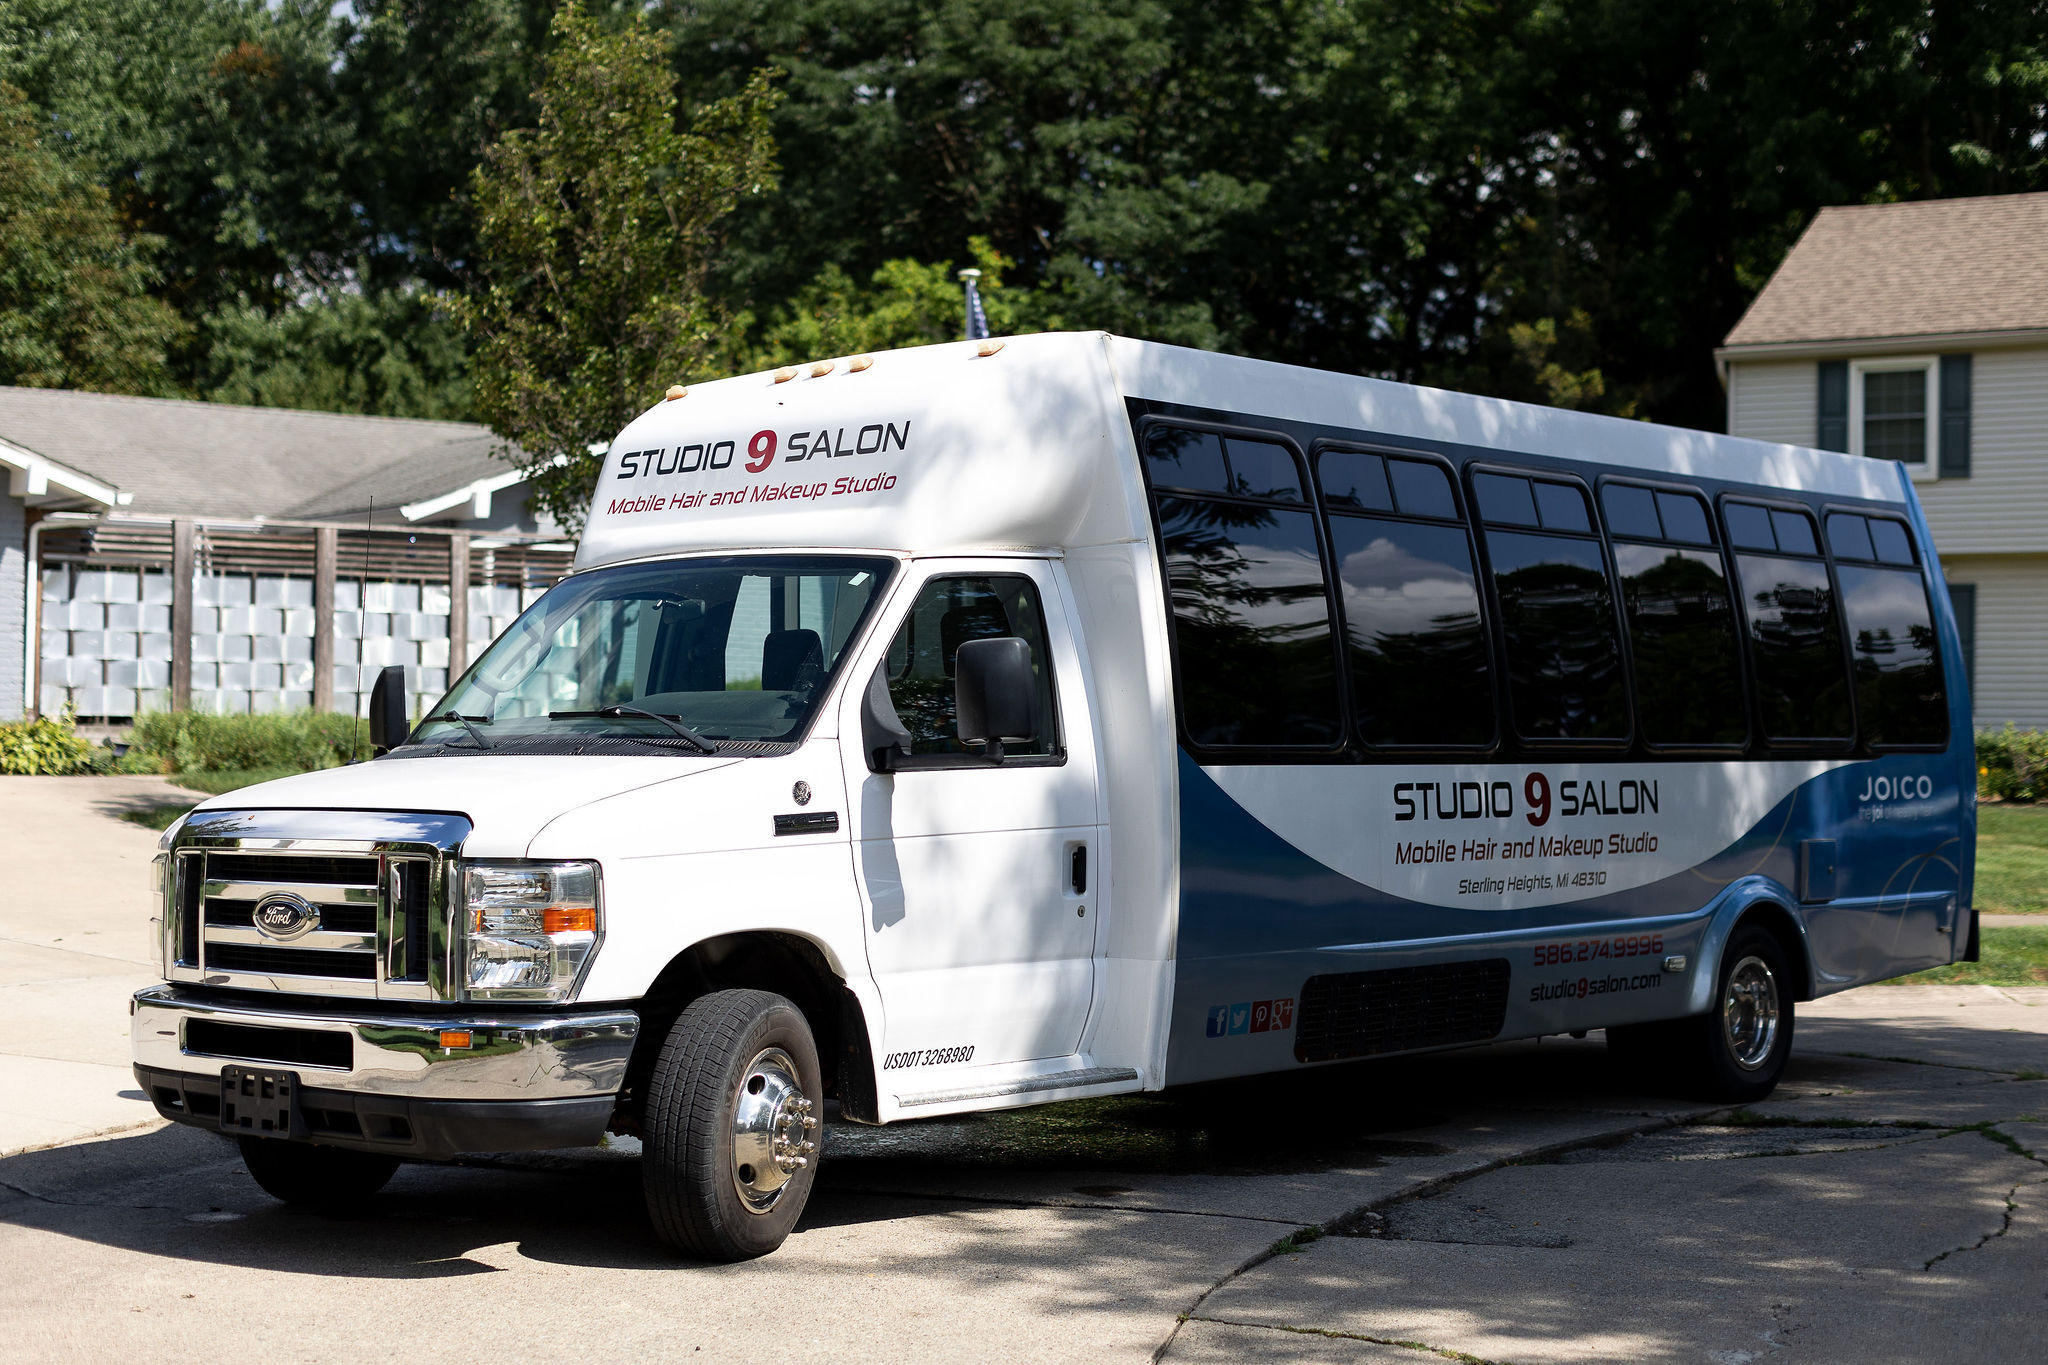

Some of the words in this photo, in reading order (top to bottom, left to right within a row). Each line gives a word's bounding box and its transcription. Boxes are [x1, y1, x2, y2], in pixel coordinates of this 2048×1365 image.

[616, 440, 736, 480] STUDIO
[744, 429, 778, 473] 9
[784, 420, 911, 463] SALON
[606, 495, 666, 516] Mobile
[669, 490, 705, 510] Hair
[708, 485, 749, 506] and
[749, 480, 828, 503] Makeup
[831, 471, 898, 495] Studio
[1393, 781, 1514, 821] STUDIO
[1524, 771, 1551, 827] 9
[1559, 779, 1660, 817] SALON
[1858, 775, 1932, 801] JOICO
[1395, 839, 1457, 865] Mobile
[1461, 837, 1498, 861] Hair
[1502, 836, 1535, 859] and
[1539, 834, 1604, 859] Makeup
[1608, 831, 1659, 855] Studio
[1458, 876, 1505, 895] Sterling
[1507, 872, 1554, 892] Heights,
[1571, 871, 1607, 888] 48310
[264, 905, 292, 925] Ford
[1533, 934, 1664, 967] 586.274.9996
[1530, 973, 1661, 1002] studio9salon.com
[884, 1050, 924, 1070] USDOT
[921, 1045, 975, 1066] 3268980
